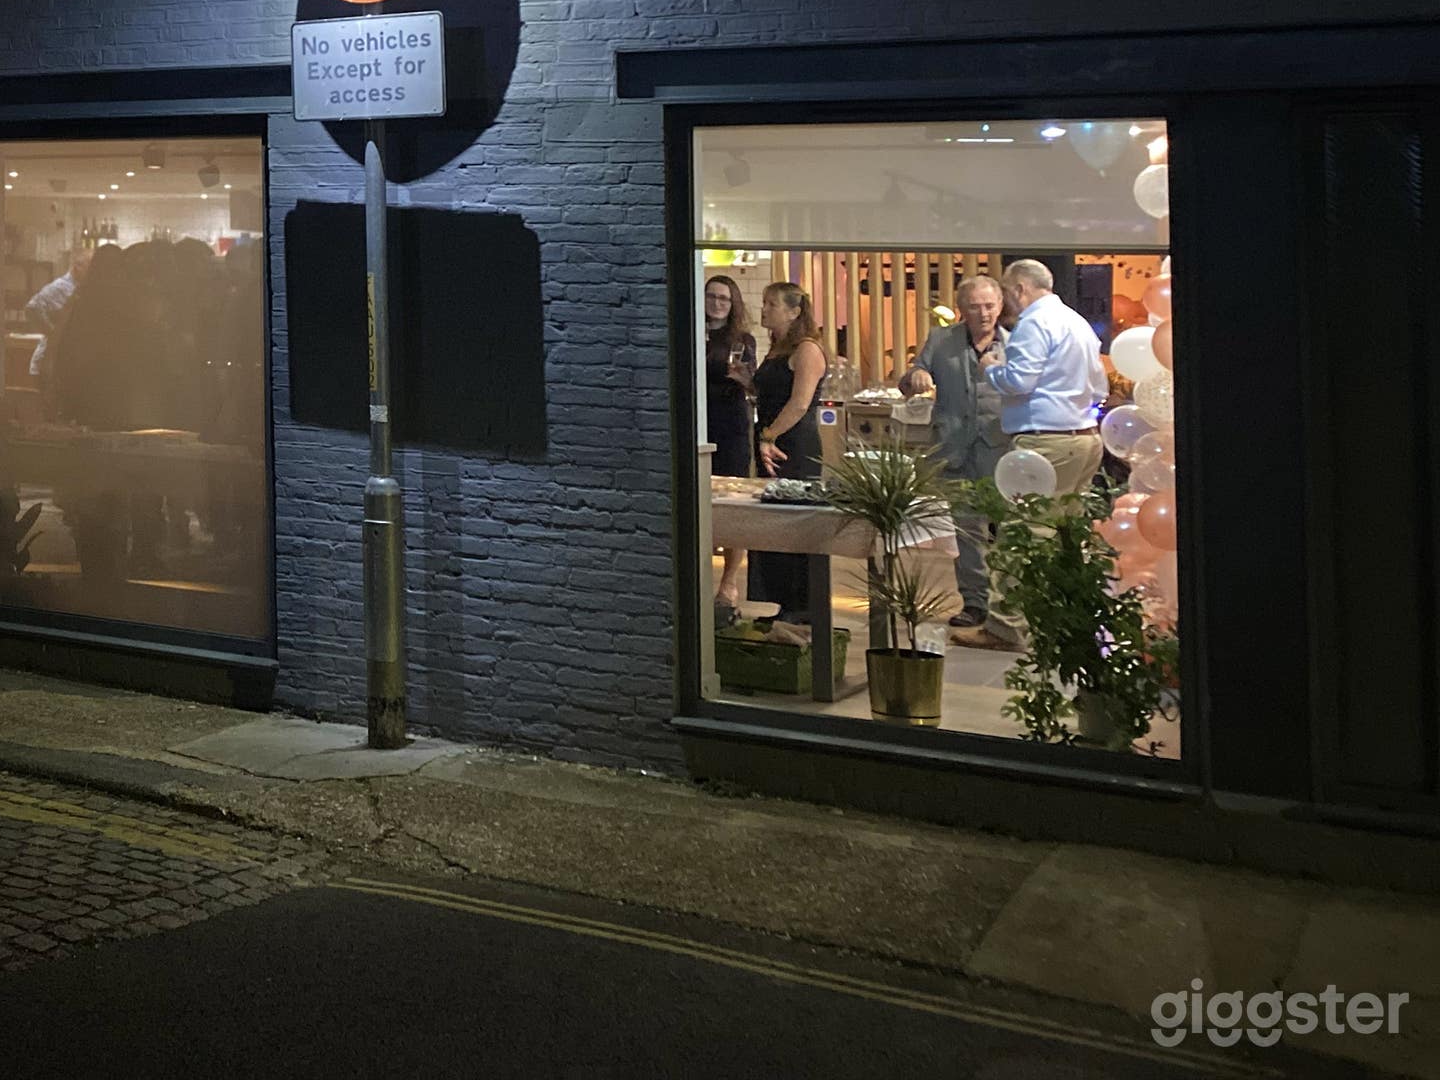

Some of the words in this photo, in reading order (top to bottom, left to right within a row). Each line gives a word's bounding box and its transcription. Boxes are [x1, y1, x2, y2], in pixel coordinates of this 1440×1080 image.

[301, 36, 330, 56] No
[341, 30, 431, 53] vehicles
[307, 58, 382, 81] Except
[394, 56, 426, 75] for
[329, 86, 406, 104] access
